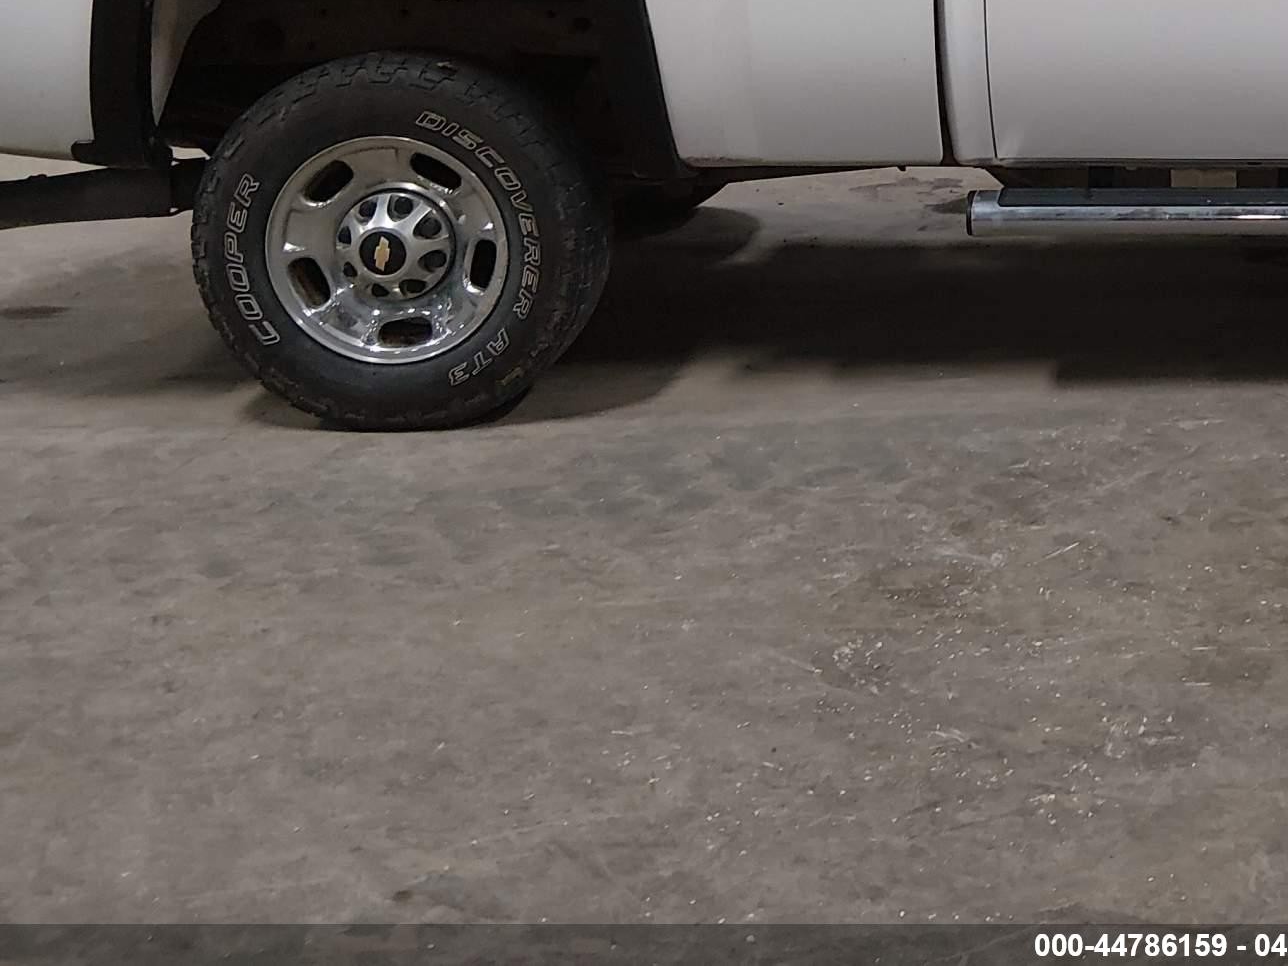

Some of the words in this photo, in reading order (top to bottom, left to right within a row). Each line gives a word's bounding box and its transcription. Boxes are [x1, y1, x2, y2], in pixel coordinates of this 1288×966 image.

[224, 173, 281, 346] COOPER
[415, 111, 541, 320] DISCOVERER
[449, 328, 511, 386] AT3
